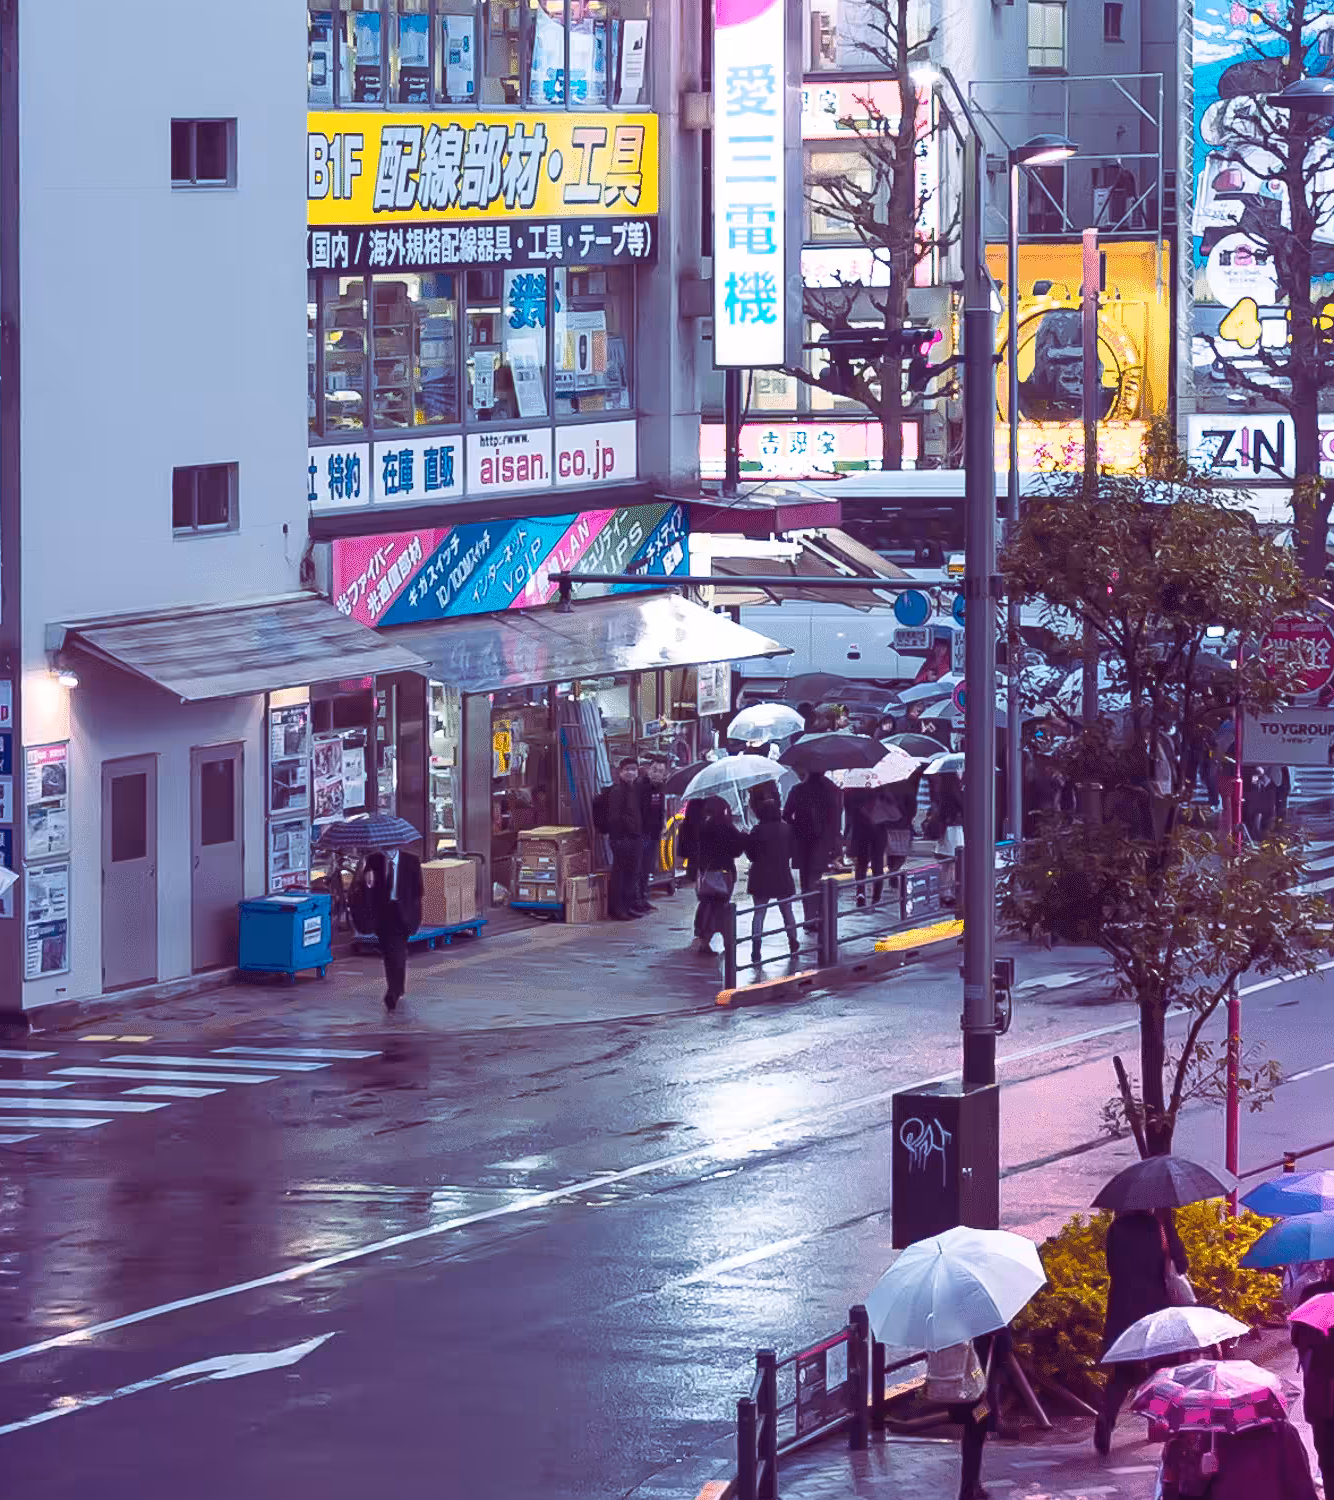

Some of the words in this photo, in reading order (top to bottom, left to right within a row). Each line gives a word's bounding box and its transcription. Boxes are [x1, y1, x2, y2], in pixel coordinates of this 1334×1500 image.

[307, 133, 365, 197] B1F
[374, 123, 645, 211] 配線部材・工具
[723, 63, 778, 328] 愛三電機
[328, 453, 361, 500] 特約
[382, 450, 414, 496] 在庫
[424, 445, 455, 492] 直販
